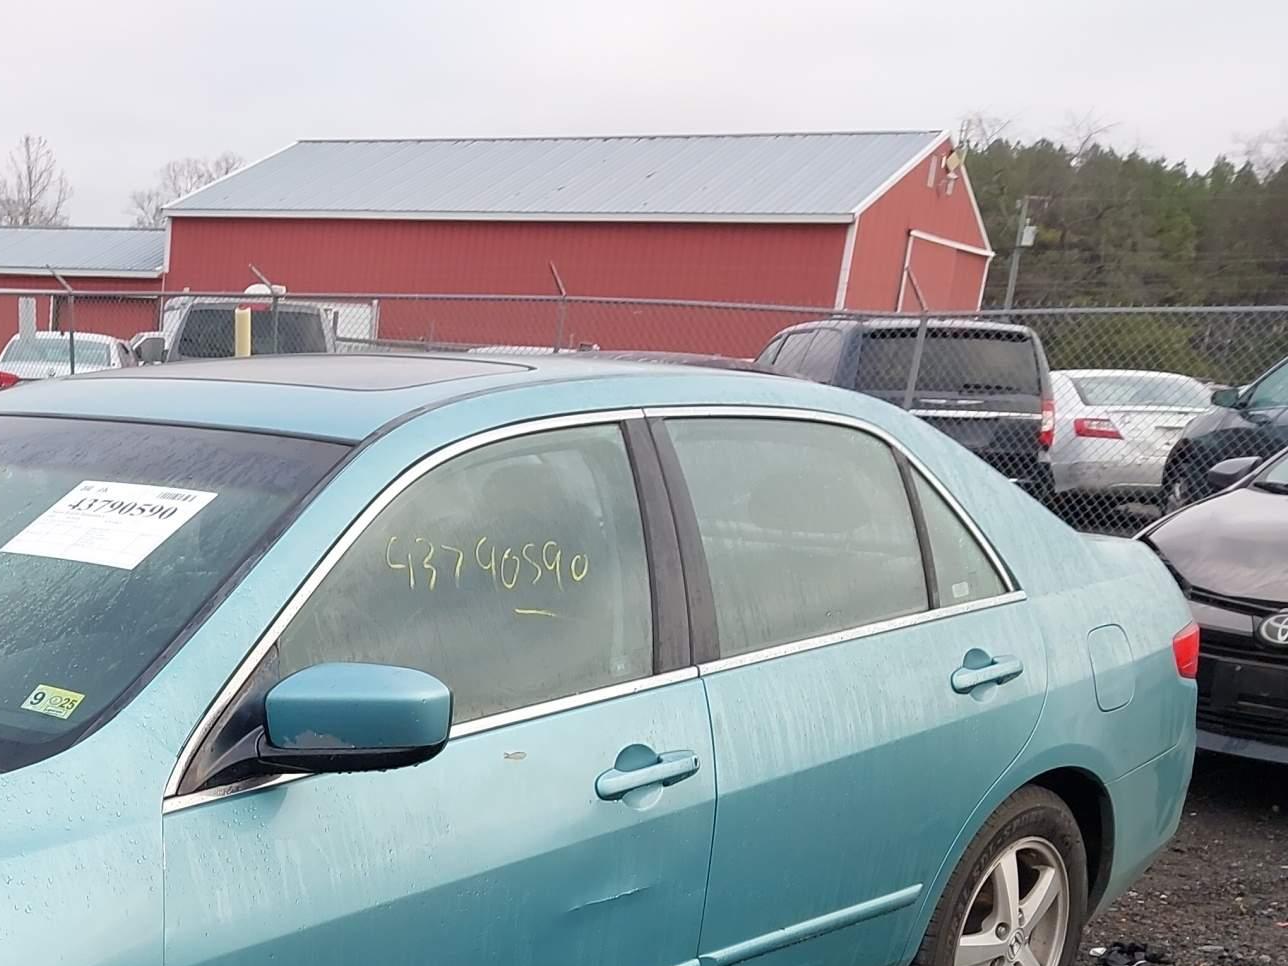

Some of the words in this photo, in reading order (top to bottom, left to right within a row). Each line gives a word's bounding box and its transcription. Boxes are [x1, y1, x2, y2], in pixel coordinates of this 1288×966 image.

[68, 497, 179, 520] 43790590
[385, 535, 590, 592] 43790590
[29, 691, 46, 706] 9
[59, 697, 78, 710] 25
